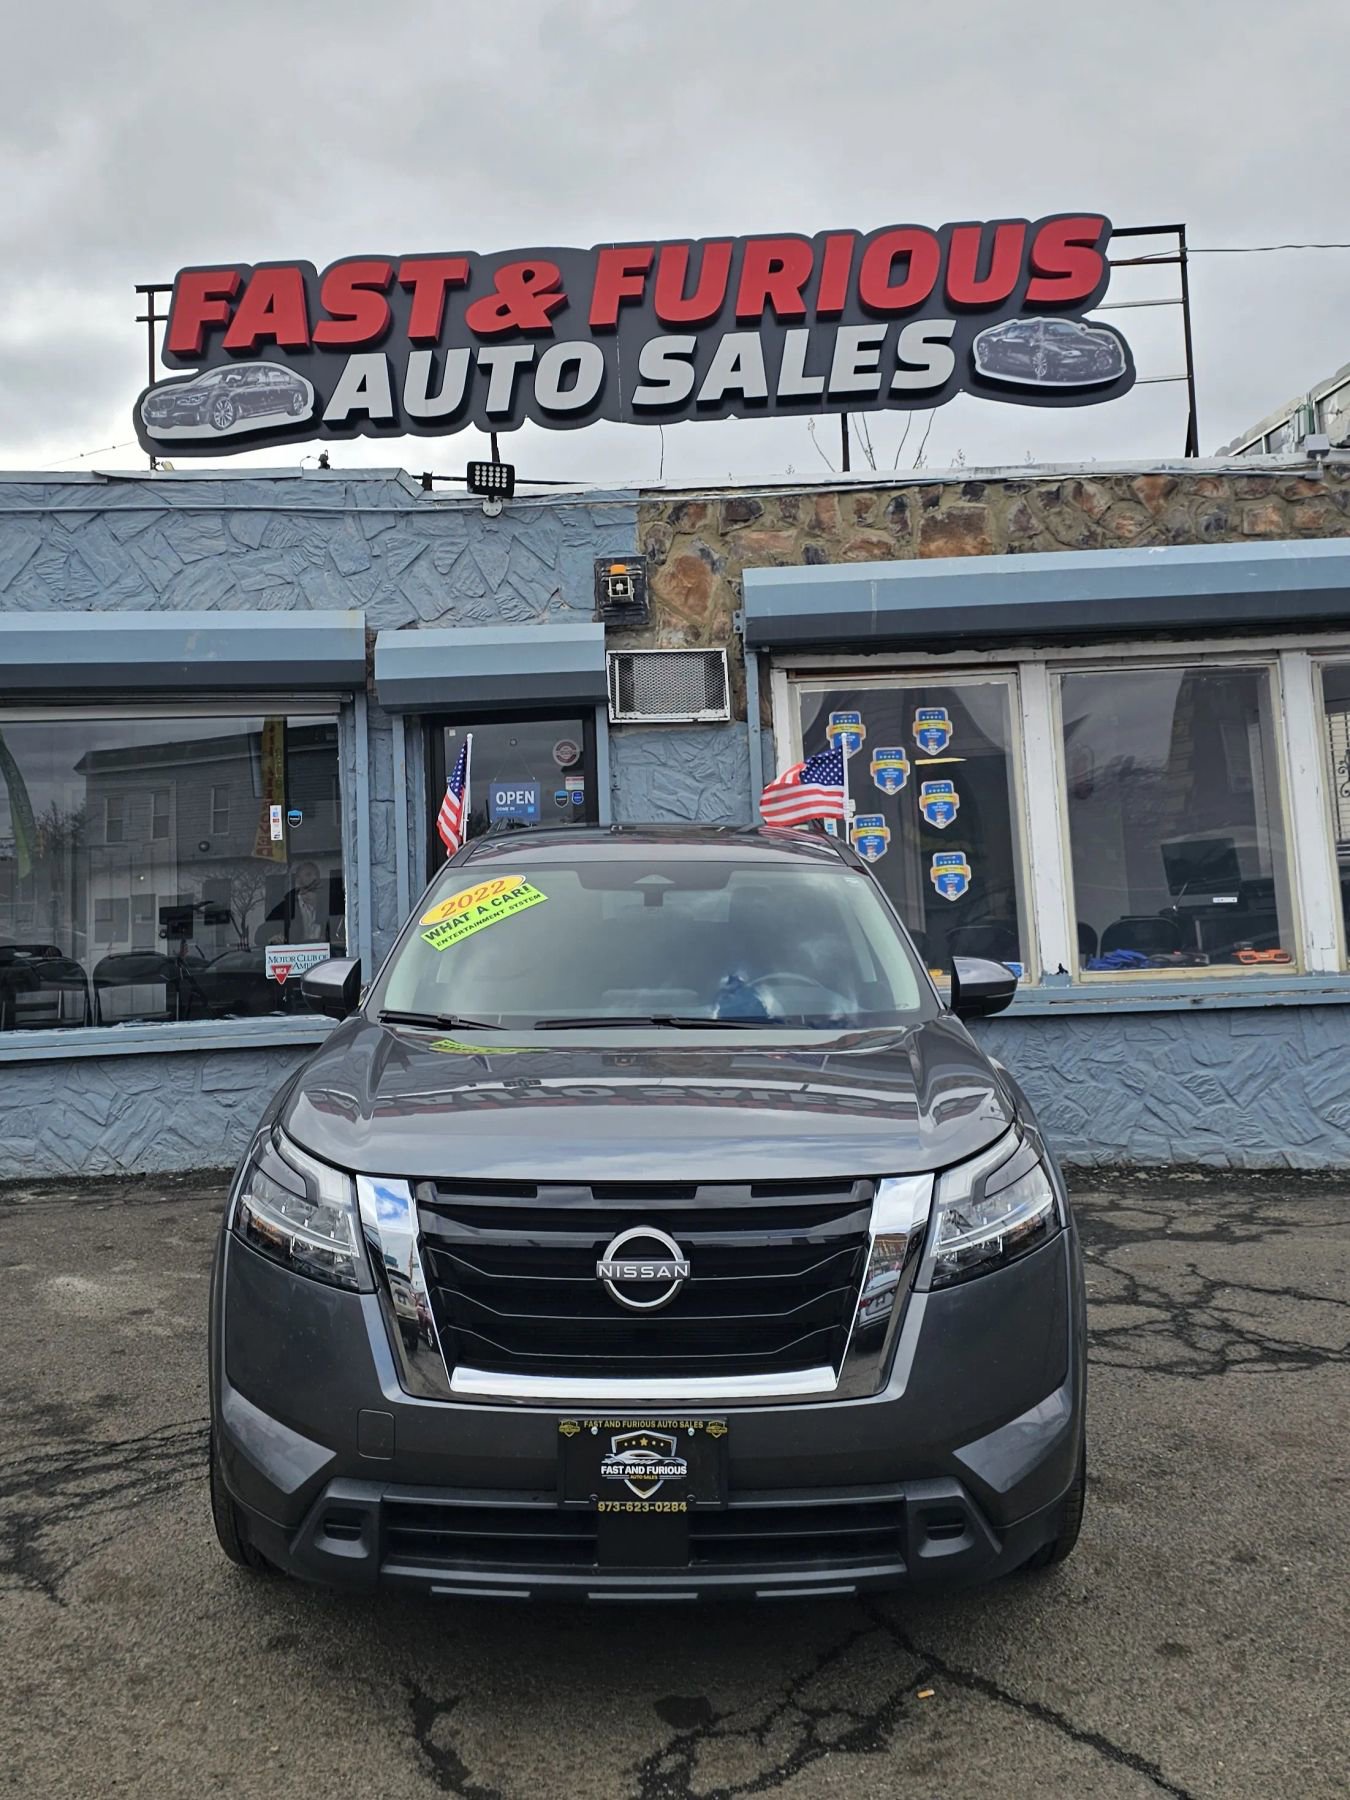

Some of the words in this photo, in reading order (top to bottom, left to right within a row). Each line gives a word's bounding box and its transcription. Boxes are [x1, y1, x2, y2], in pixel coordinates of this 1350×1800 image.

[168, 257, 471, 353] FAST
[465, 260, 568, 336] &
[589, 217, 1106, 330] FURIOUS
[322, 340, 605, 422] AUTO
[631, 319, 957, 410] SALES
[495, 790, 535, 805] OPEN
[440, 880, 506, 918] 2022
[425, 912, 471, 941] WHAT
[476, 906, 490, 915] A
[491, 885, 532, 907] CAR!
[436, 909, 505, 947] ENTERTAINMENT
[508, 893, 542, 911] SYSTEM
[268, 956, 296, 964] MOTOR
[297, 954, 318, 962] CLUB
[598, 1264, 688, 1278] NISSAN
[584, 1420, 602, 1428] FAST
[604, 1420, 621, 1428] AND
[622, 1420, 656, 1428] FURIOUS
[679, 1421, 703, 1429] SALES
[601, 1466, 624, 1474] FAST
[625, 1466, 646, 1474] AND
[646, 1466, 687, 1474] FURIOUS
[597, 1502, 688, 1512] 973-623-0284
